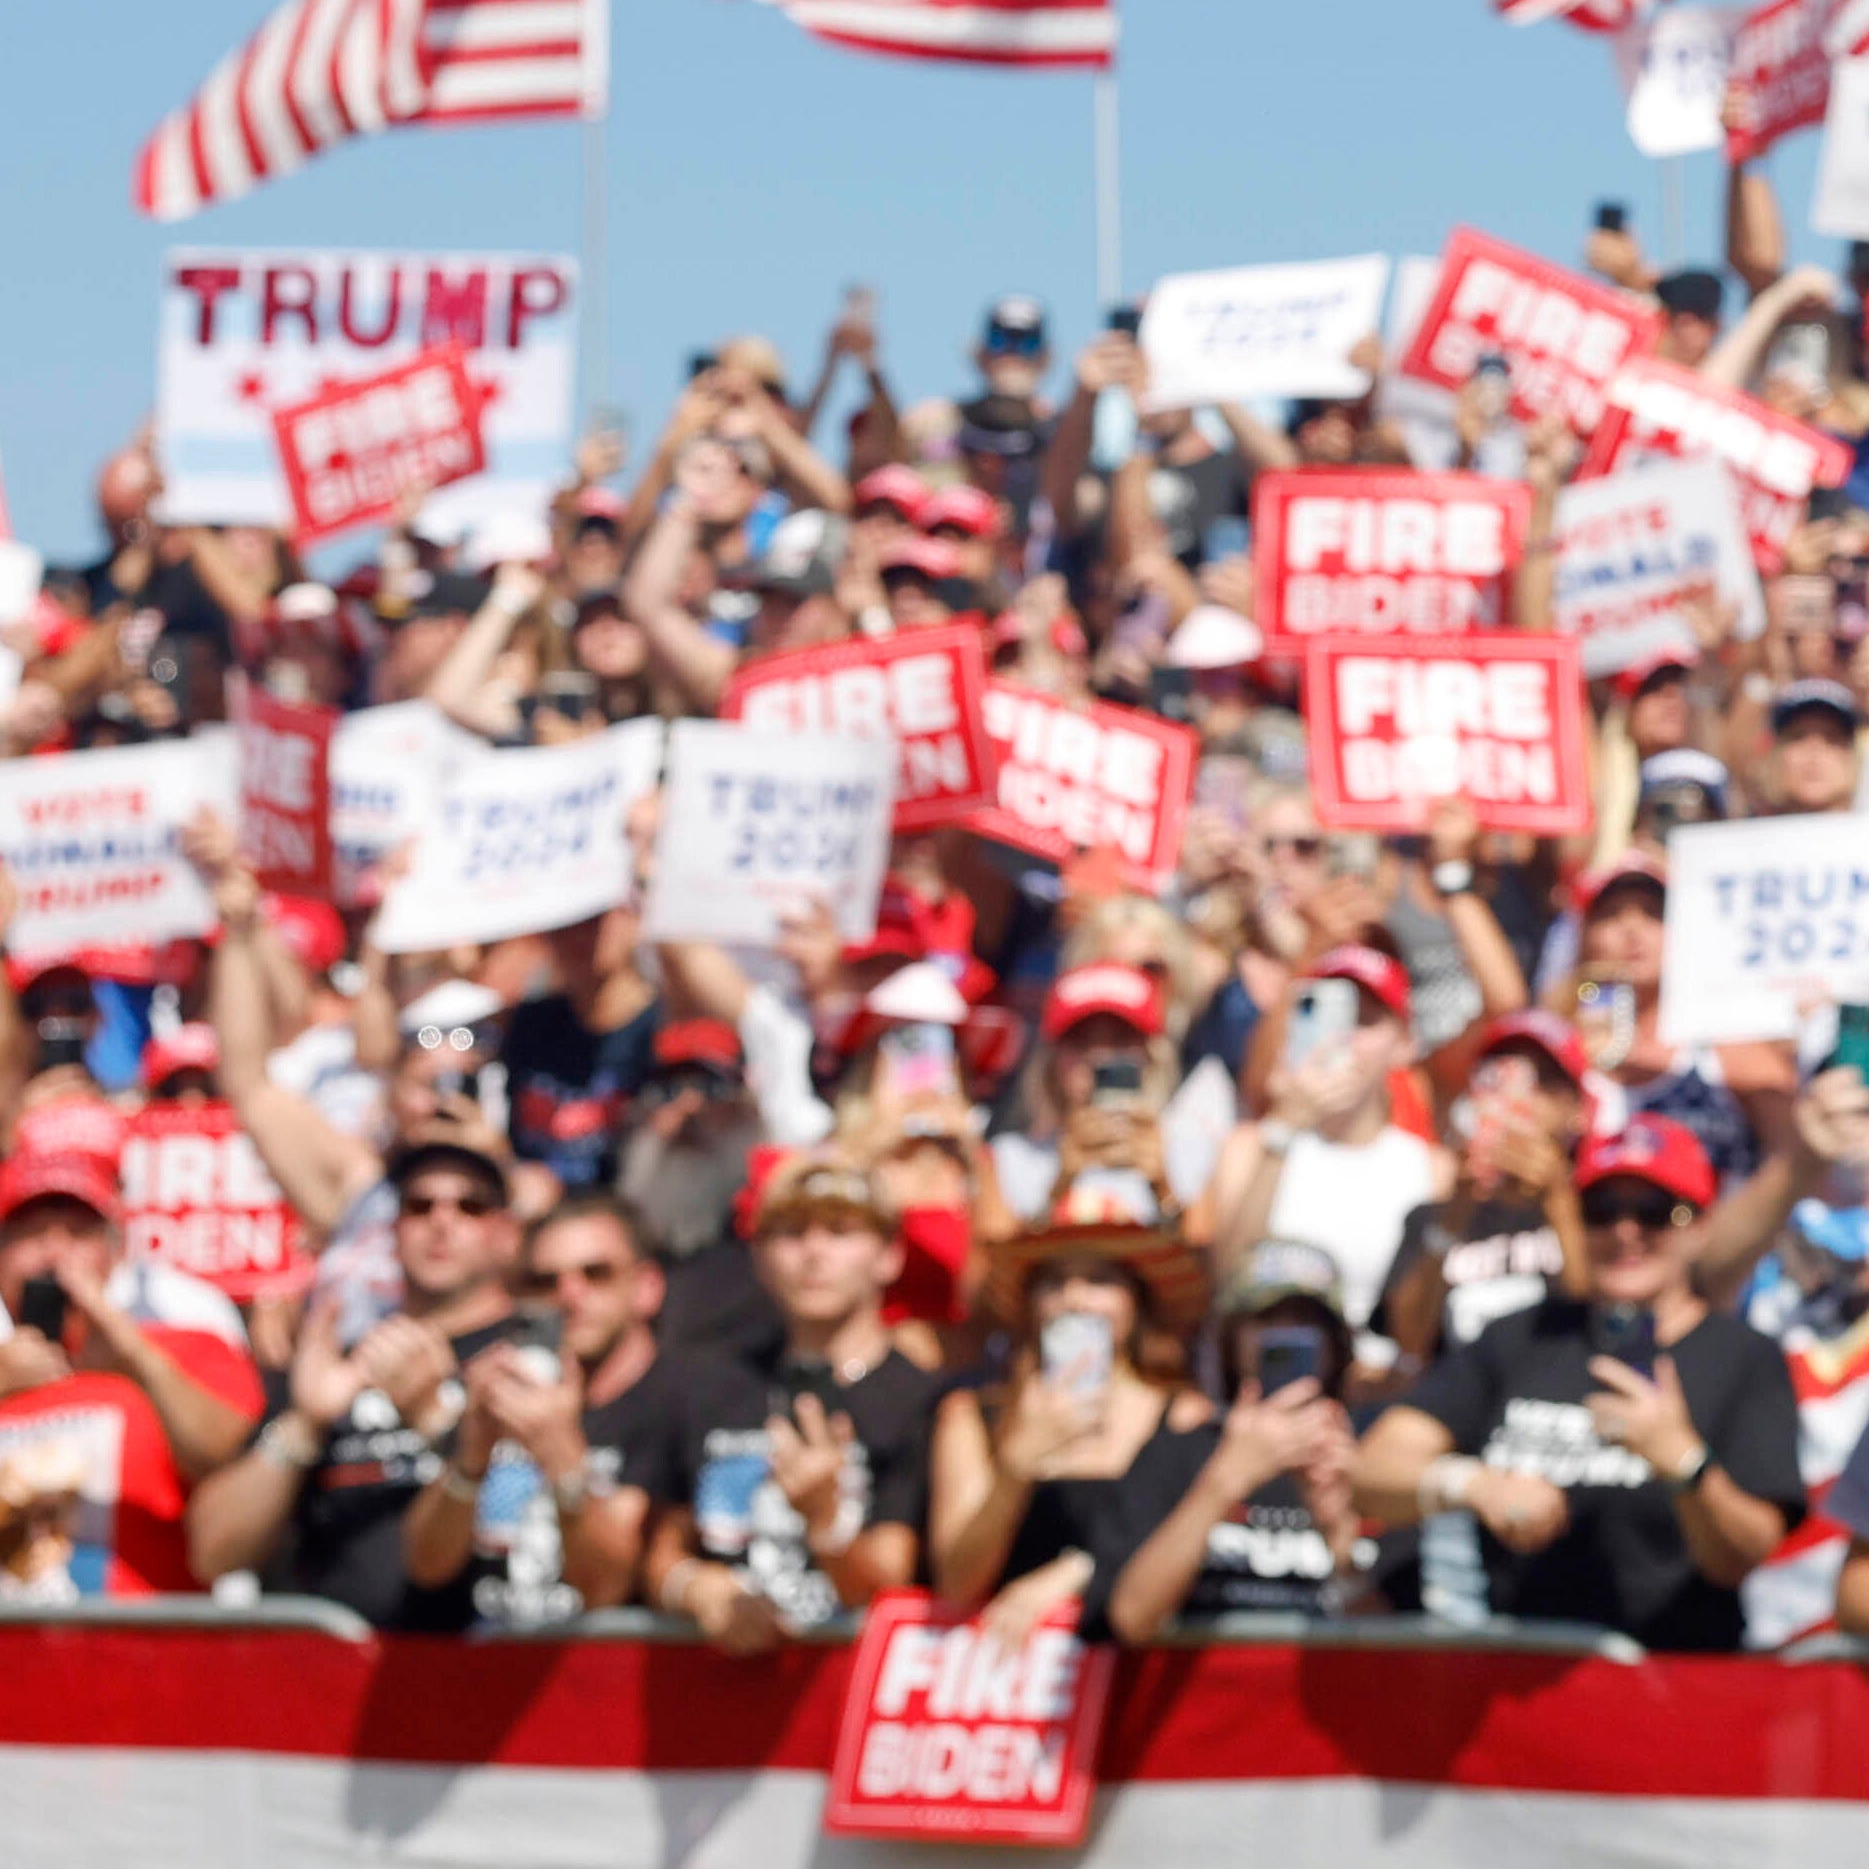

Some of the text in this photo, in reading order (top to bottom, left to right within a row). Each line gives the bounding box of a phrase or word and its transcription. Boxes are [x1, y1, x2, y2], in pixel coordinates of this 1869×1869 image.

[173, 265, 569, 349] TRUMP
[1449, 259, 1633, 379] FIRE
[293, 363, 462, 471] FIRE
[1286, 497, 1506, 575] FIRE
[743, 652, 960, 734] FIRE
[1336, 655, 1552, 740] FIRE
[983, 685, 1164, 804] FIRE
[1341, 736, 1558, 803] BIEN
[998, 764, 1158, 861] IDEN
[120, 1132, 284, 1210] IRE
[126, 1210, 283, 1272] DEN
[874, 1623, 1078, 1720] FIRE
[857, 1724, 1066, 1803] BIDEN
